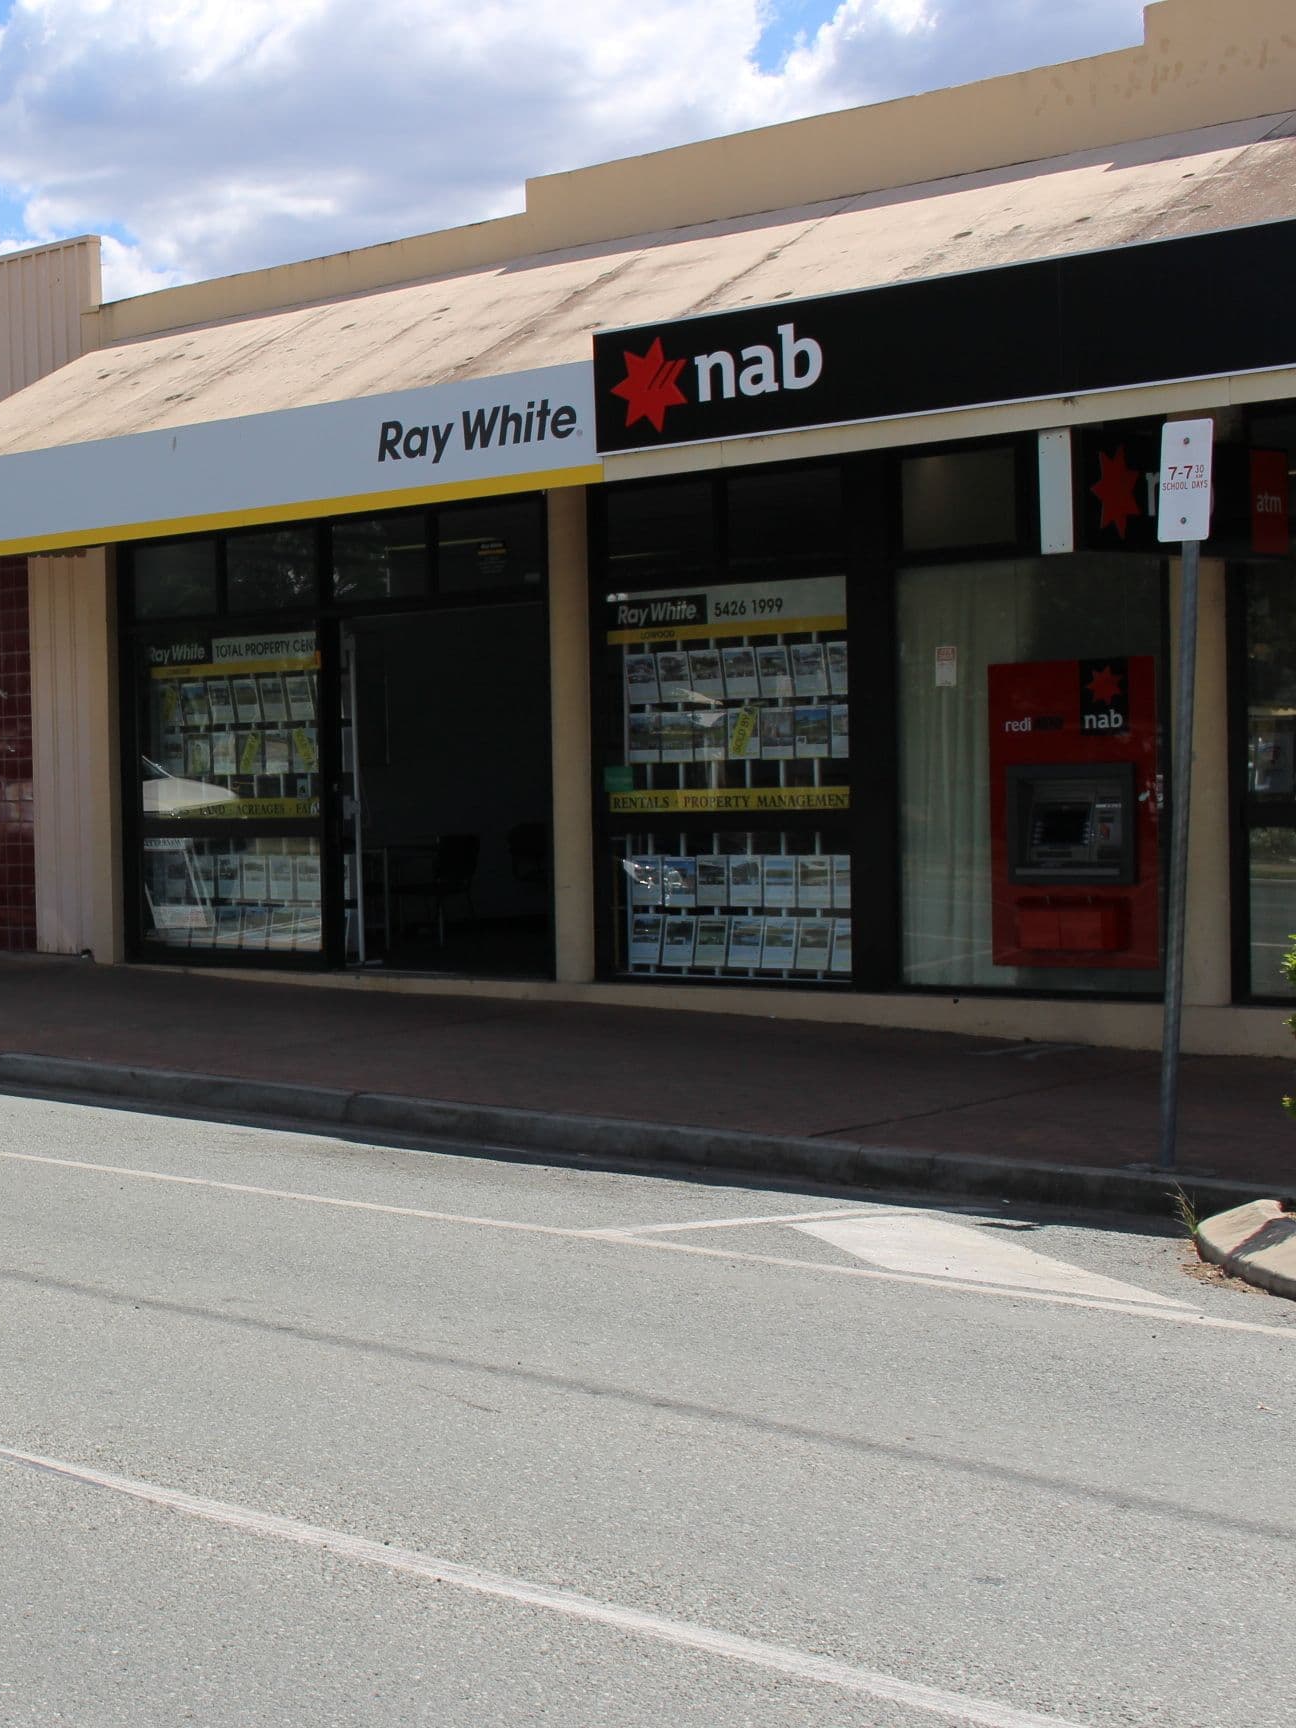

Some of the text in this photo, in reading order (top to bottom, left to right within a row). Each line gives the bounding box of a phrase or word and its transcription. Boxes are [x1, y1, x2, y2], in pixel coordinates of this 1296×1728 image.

[694, 322, 823, 402] nab
[377, 399, 577, 464] Ray White
[1162, 479, 1208, 491] SCHOOL DAYS
[1257, 493, 1282, 512] atm
[617, 600, 697, 626] Ray White
[714, 598, 783, 617] 5426 1999
[216, 644, 243, 658] TOTAL
[245, 641, 290, 656] PROPERTY
[1084, 709, 1124, 729] nab
[613, 796, 670, 809] RENTALS
[684, 795, 751, 808] PROPERTY
